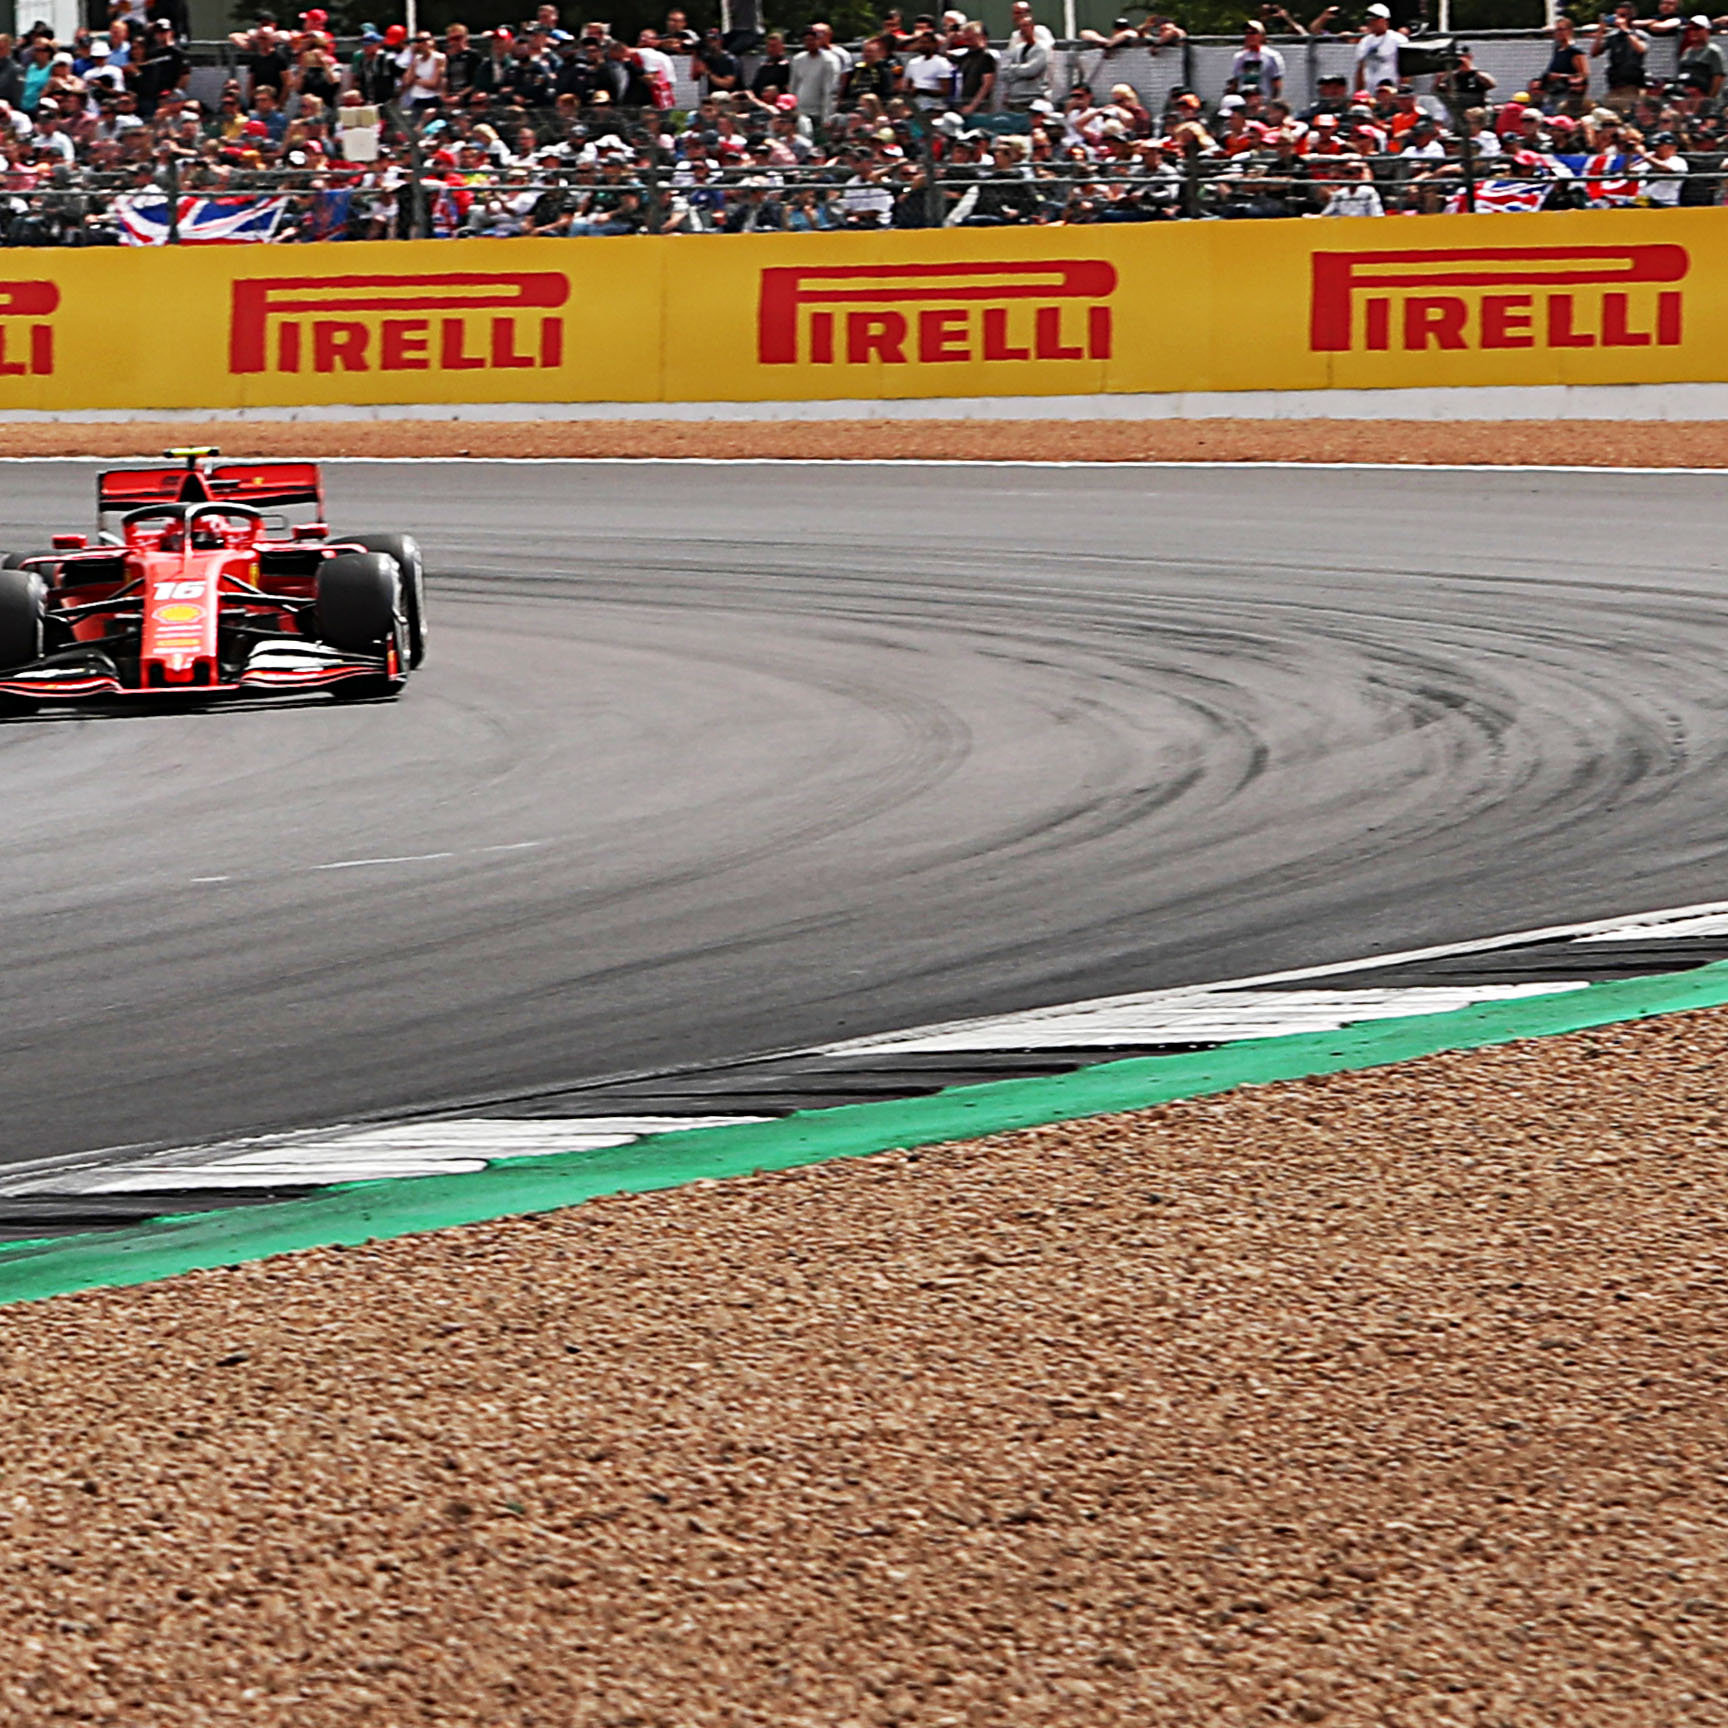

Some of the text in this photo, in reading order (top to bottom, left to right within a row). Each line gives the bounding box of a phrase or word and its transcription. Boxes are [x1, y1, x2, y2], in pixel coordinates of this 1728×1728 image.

[228, 270, 572, 375] PIRELLI
[757, 258, 1119, 366] PIRELLI
[1309, 242, 1691, 353] PIRELLI
[153, 580, 207, 600] 16
